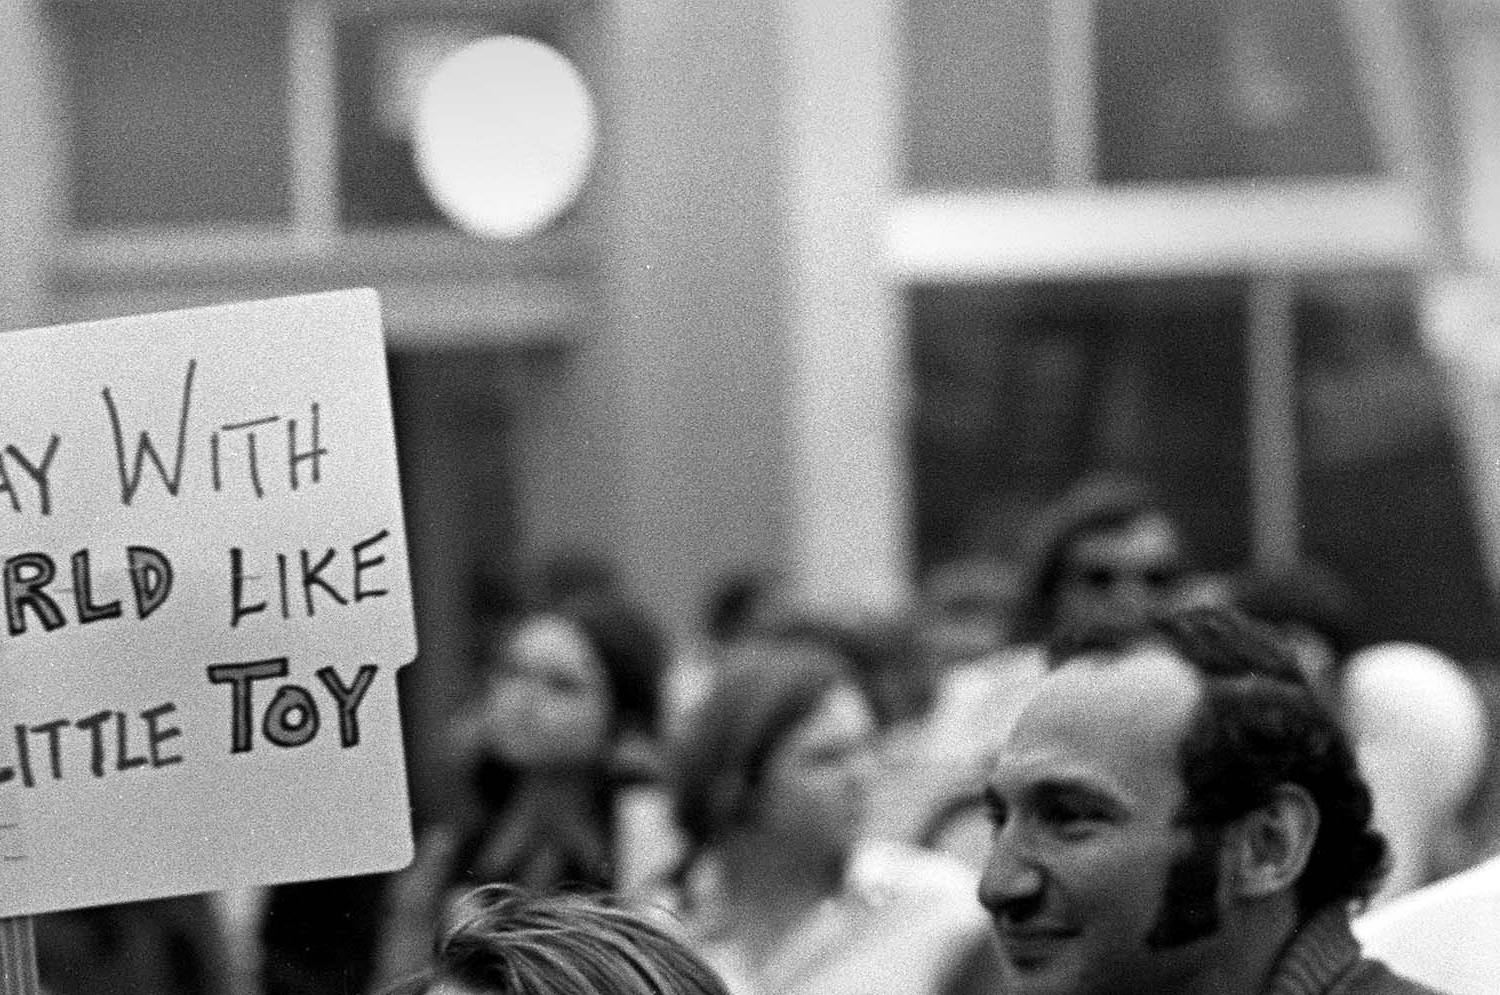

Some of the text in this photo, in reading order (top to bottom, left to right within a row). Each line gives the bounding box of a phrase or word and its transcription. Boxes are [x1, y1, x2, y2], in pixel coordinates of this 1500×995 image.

[103, 359, 327, 504] WITH
[231, 530, 390, 626] LIKE
[208, 658, 378, 753] TOY
